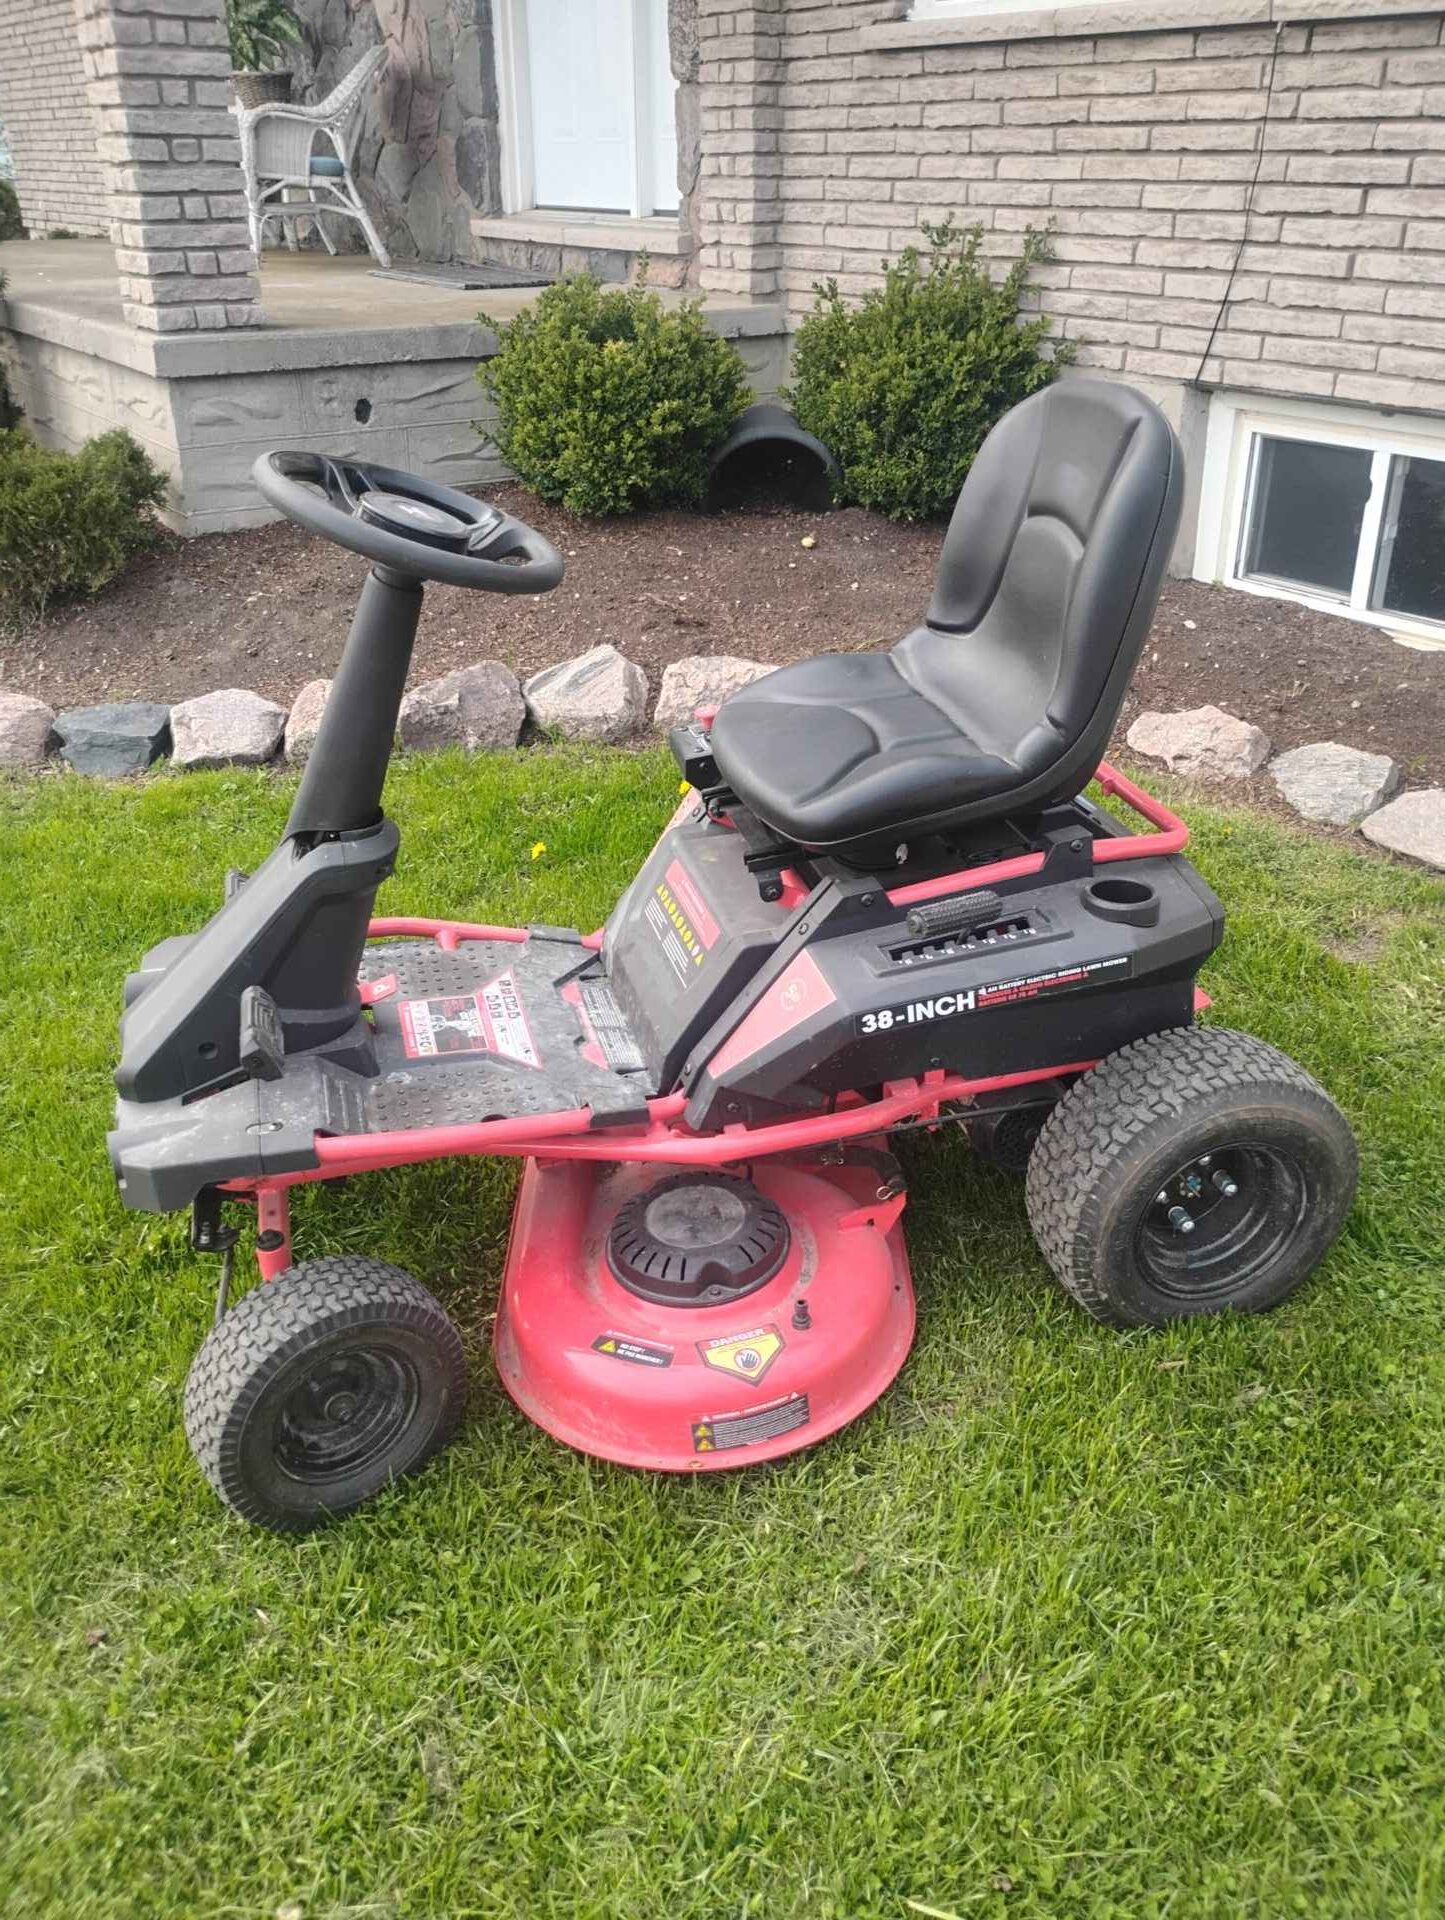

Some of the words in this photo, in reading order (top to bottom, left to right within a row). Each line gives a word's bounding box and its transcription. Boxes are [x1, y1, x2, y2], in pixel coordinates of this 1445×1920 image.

[998, 979, 1026, 990] BATTERY
[1026, 972, 1057, 984] ELECTRIC
[1083, 962, 1102, 971] LAWN
[1102, 956, 1128, 967] MOWER
[861, 990, 976, 1033] 38-INCH
